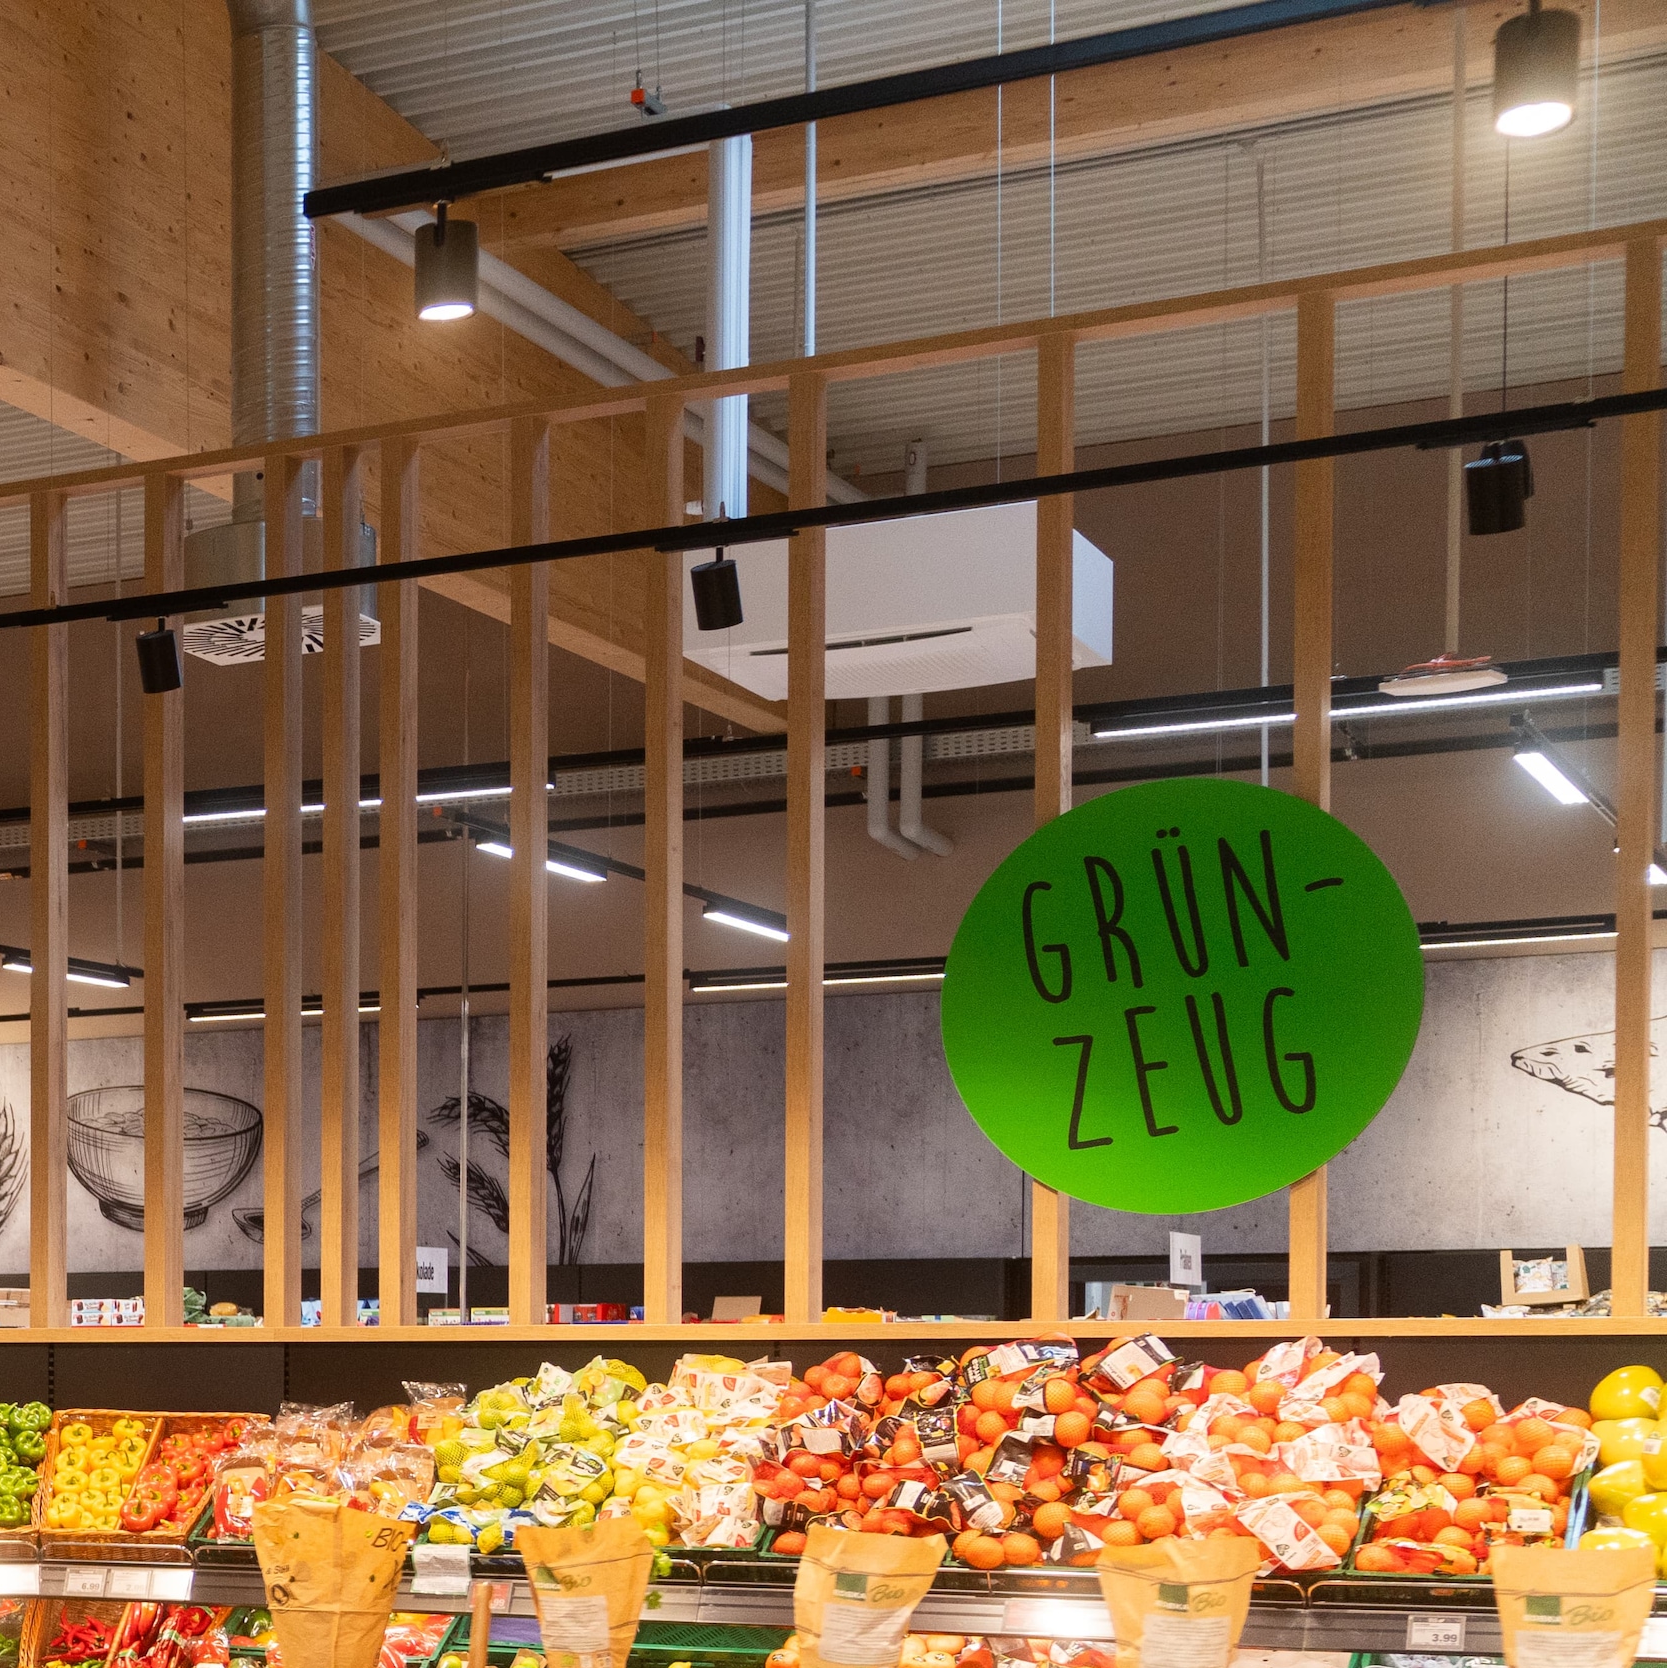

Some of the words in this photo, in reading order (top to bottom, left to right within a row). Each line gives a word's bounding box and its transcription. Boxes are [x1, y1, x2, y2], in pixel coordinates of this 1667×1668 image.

[1021, 826, 1344, 1004] GRÜN-
[1052, 986, 1317, 1150] ZEUG
[1431, 1633, 1457, 1643] 3.99
[1568, 1605, 1613, 1625] Bio
